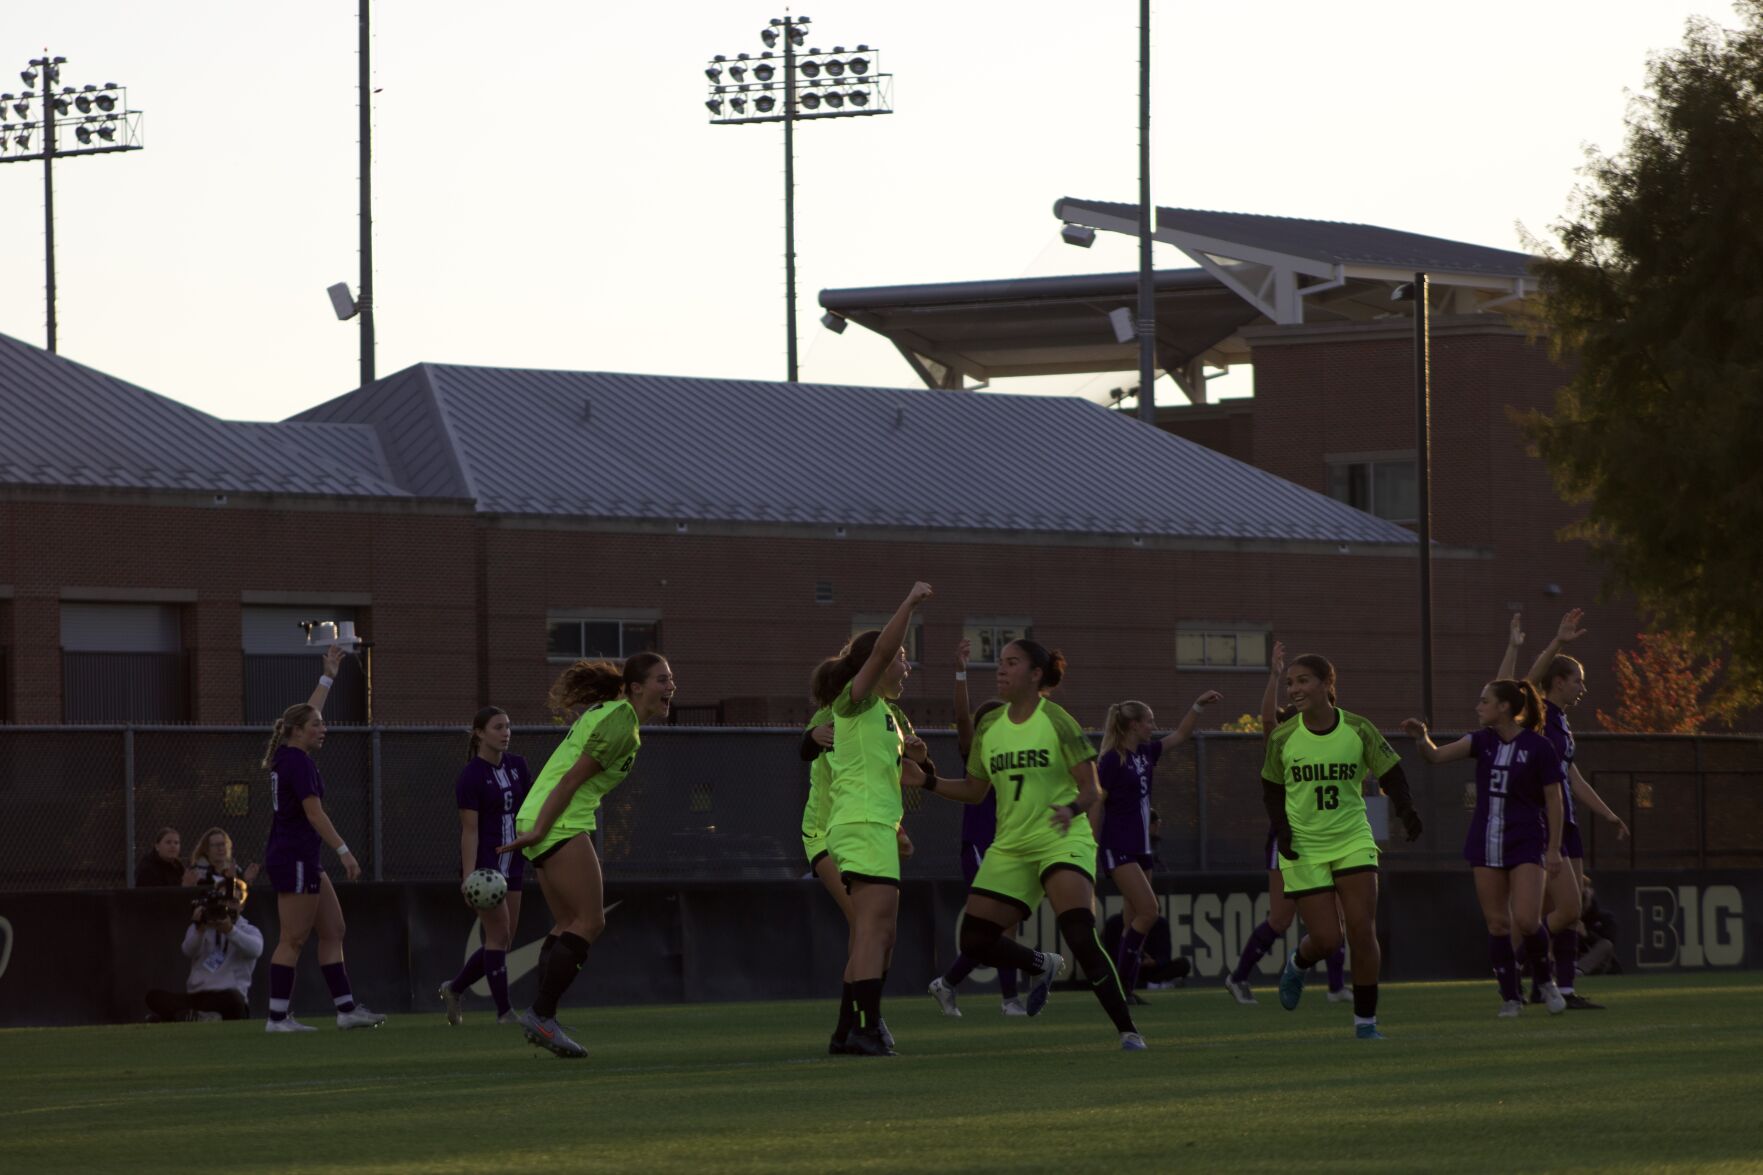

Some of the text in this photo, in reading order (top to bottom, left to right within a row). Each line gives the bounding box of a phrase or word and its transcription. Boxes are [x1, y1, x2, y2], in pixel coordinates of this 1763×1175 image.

[990, 749, 1049, 774] BOILERS
[1516, 749, 1528, 763] N
[1291, 763, 1357, 782] BOILERS
[1489, 768, 1509, 793] 21
[1009, 773, 1024, 802] 7
[1315, 785, 1339, 811] 13
[503, 790, 513, 811] 6
